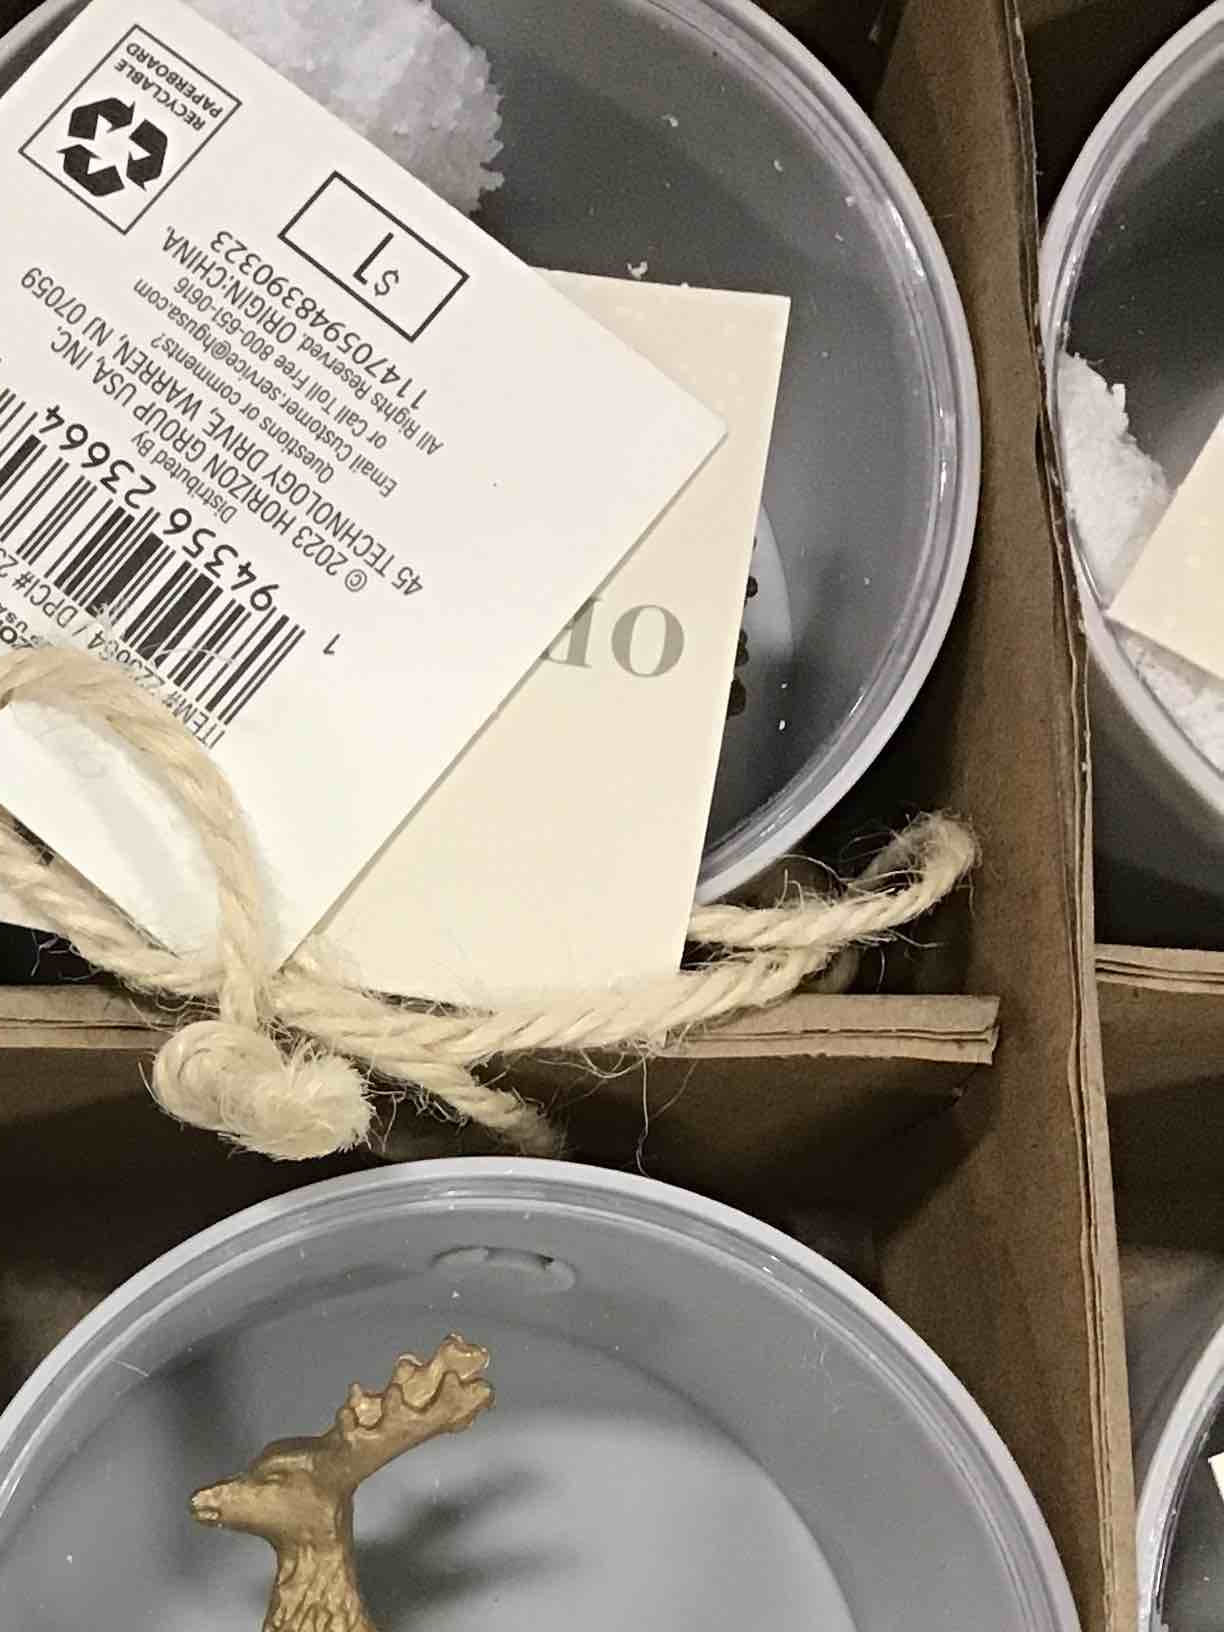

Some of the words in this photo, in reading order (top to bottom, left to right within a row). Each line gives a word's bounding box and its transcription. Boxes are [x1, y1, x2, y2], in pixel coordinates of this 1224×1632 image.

[112, 57, 207, 132] RECYCLABLE
[124, 41, 224, 119] PAPERBOARD
[19, 266, 88, 326] 07059
[161, 224, 297, 344] ORIGIN:CHINA.
[350, 230, 400, 297] $1
[49, 324, 94, 371] INC.
[80, 315, 115, 348] NJ
[172, 275, 275, 362] 800-651-0616
[208, 229, 428, 411] 114705948390323
[91, 354, 138, 408] USA,
[110, 332, 204, 423] WARREN,
[132, 277, 353, 462] Customer.service@hgusa.com
[148, 331, 242, 406] comments?
[272, 353, 311, 391] Free
[295, 331, 373, 401] Reserved.
[303, 380, 338, 416] Toll
[129, 428, 156, 459] By
[131, 400, 207, 463] GROUP
[200, 405, 270, 473] DRIVE,
[237, 401, 261, 421] or
[332, 403, 369, 438] Call
[364, 429, 388, 450] or
[369, 390, 421, 441] Rights
[414, 430, 445, 456] All
[37, 403, 157, 510] 23664
[257, 414, 335, 485] Questions
[347, 452, 398, 499] Email
[148, 447, 238, 525] Distributed
[200, 451, 297, 537] HORIZON
[260, 462, 395, 578] TECHNOLOGY
[290, 524, 349, 577] 2023
[161, 506, 280, 612] 94356
[389, 564, 423, 596] 45
[10, 569, 79, 629] DPCI#
